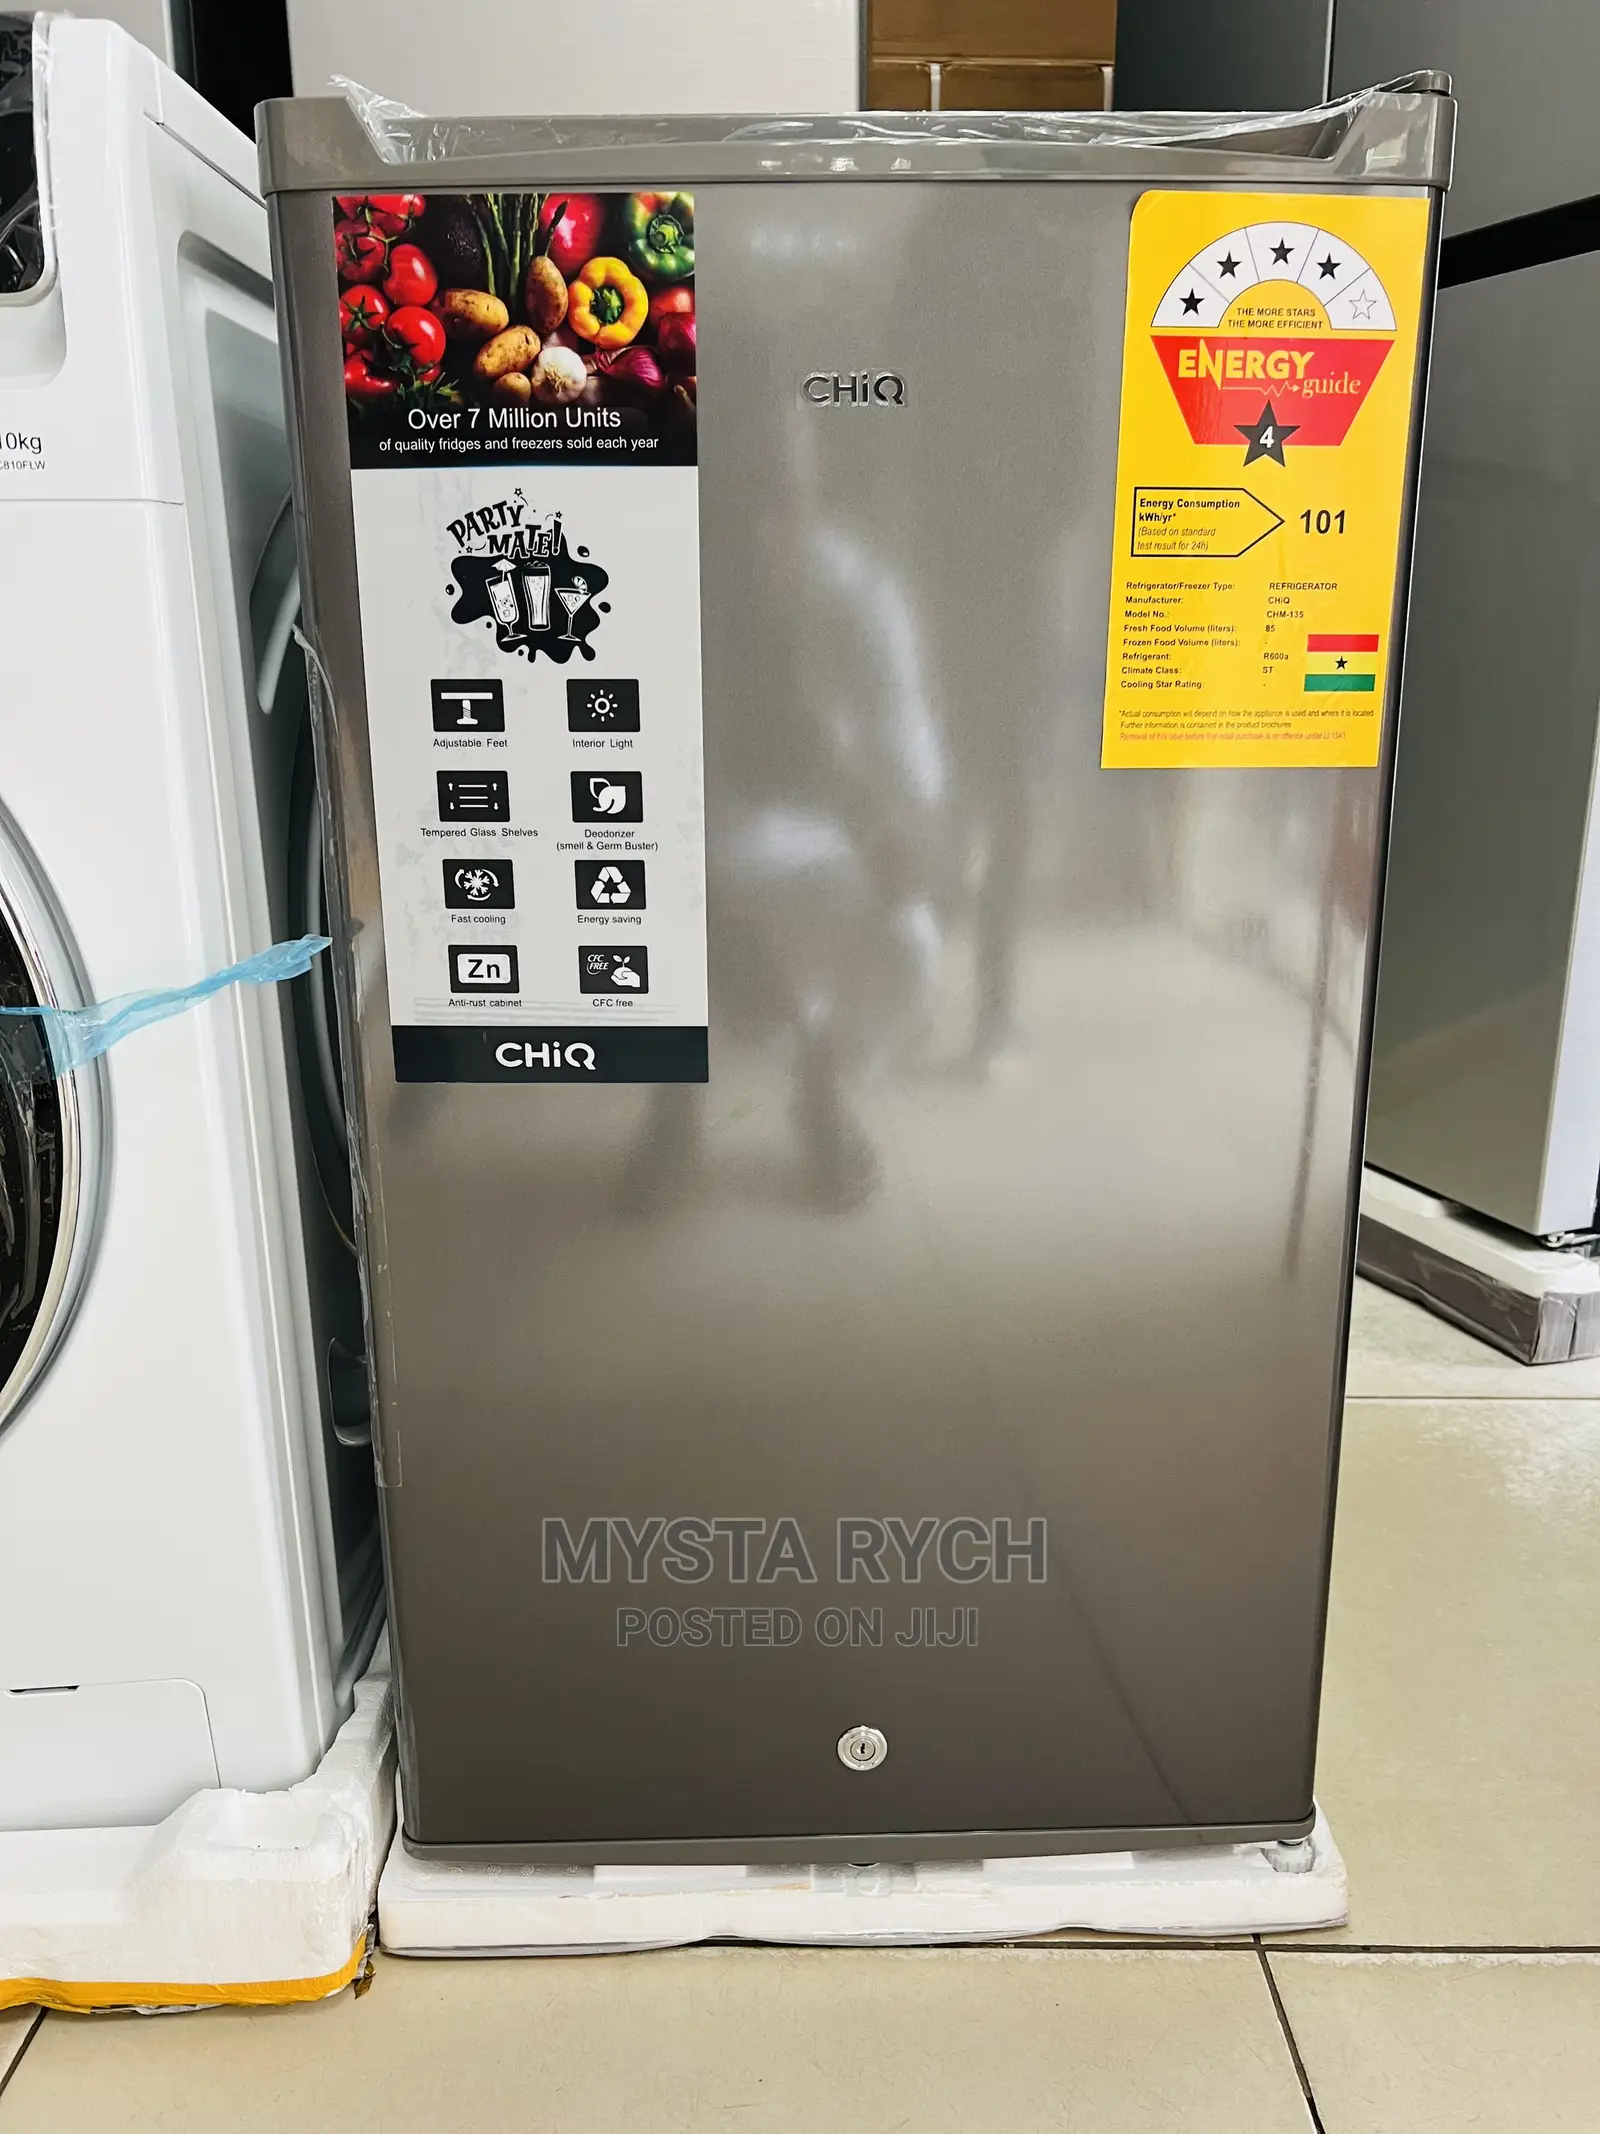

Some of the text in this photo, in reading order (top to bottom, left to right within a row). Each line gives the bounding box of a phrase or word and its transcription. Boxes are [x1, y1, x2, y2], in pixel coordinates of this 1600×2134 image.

[1257, 308, 1285, 316] MORE
[1287, 309, 1316, 317] STARS
[1228, 320, 1323, 329] THE MORE EFFICIENT
[1178, 338, 1315, 391] ENERGY
[1302, 371, 1361, 398] guide
[408, 407, 621, 429] Over 7 Million Units
[1259, 426, 1274, 448] 4
[379, 436, 658, 453] of quality fridges and freezers sold each year
[1140, 498, 1240, 510] Energy Consumption
[446, 500, 525, 548] PARTY
[1299, 509, 1346, 534] 101
[1138, 526, 1167, 537] (Based
[1181, 528, 1216, 536] standard
[487, 519, 562, 559] MATE!
[1137, 541, 1209, 552] test result for 24h)
[1126, 582, 1235, 591] Refrigerator/Freezer Type:
[1269, 582, 1337, 590] REFRIGERATOR
[1126, 596, 1183, 604] Manufacturer:
[1123, 653, 1171, 661] Refrigerant:
[1121, 681, 1153, 689] Cooling
[1175, 681, 1204, 689] Rating:
[433, 738, 508, 749] Adjustable Feet
[572, 739, 633, 750] Interior Light
[420, 828, 538, 838] Tempered Glass Shelves
[584, 829, 635, 838] Deodorizer
[556, 841, 658, 851] (smell & Germ Buster)
[451, 915, 506, 924] Fast cooling
[577, 915, 642, 925] Energy saving
[588, 954, 604, 962] CFC
[468, 959, 501, 979] Zn
[589, 962, 609, 970] FREE
[448, 999, 522, 1007] Anti-rust cabinet
[592, 999, 634, 1007] CFC free
[495, 1041, 596, 1070] CHiQ
